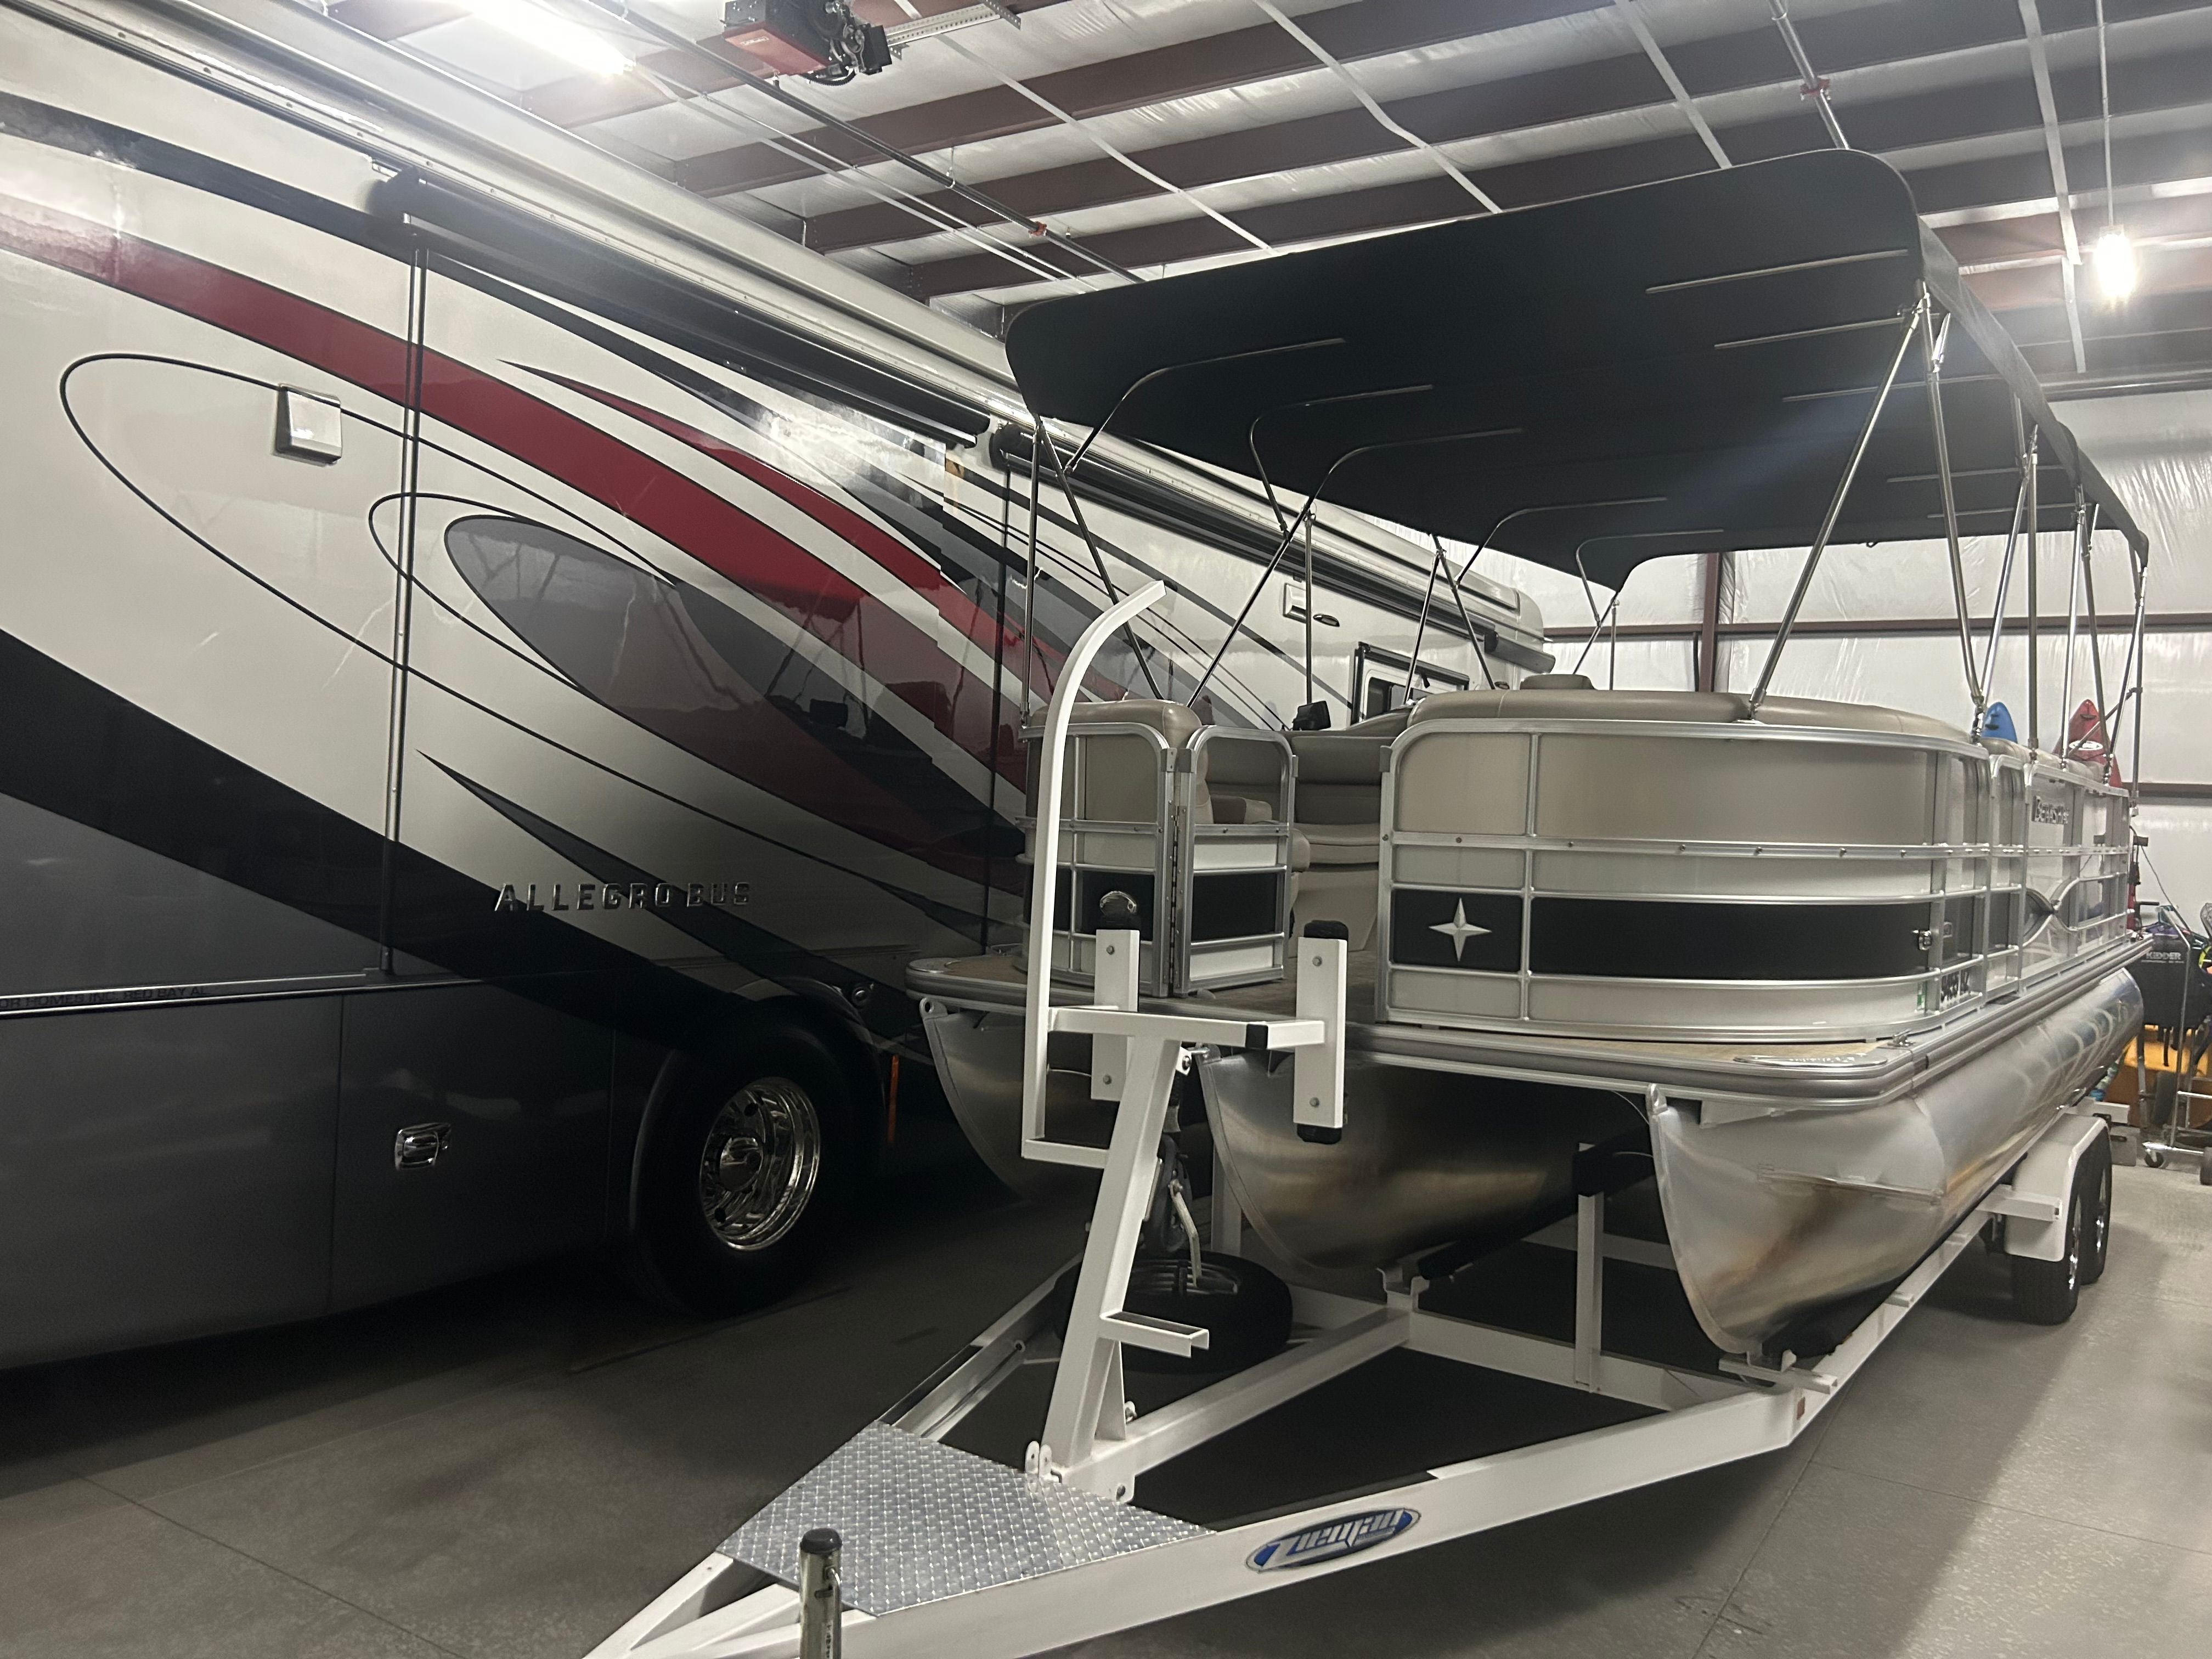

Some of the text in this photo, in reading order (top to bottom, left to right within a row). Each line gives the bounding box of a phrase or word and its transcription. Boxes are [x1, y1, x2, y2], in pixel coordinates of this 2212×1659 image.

[494, 882, 751, 911] ALLEGRO BUS
[26, 994, 84, 1007] HOMES
[123, 989, 153, 1000] RED
[157, 987, 186, 997] BAY
[190, 986, 210, 996] AL
